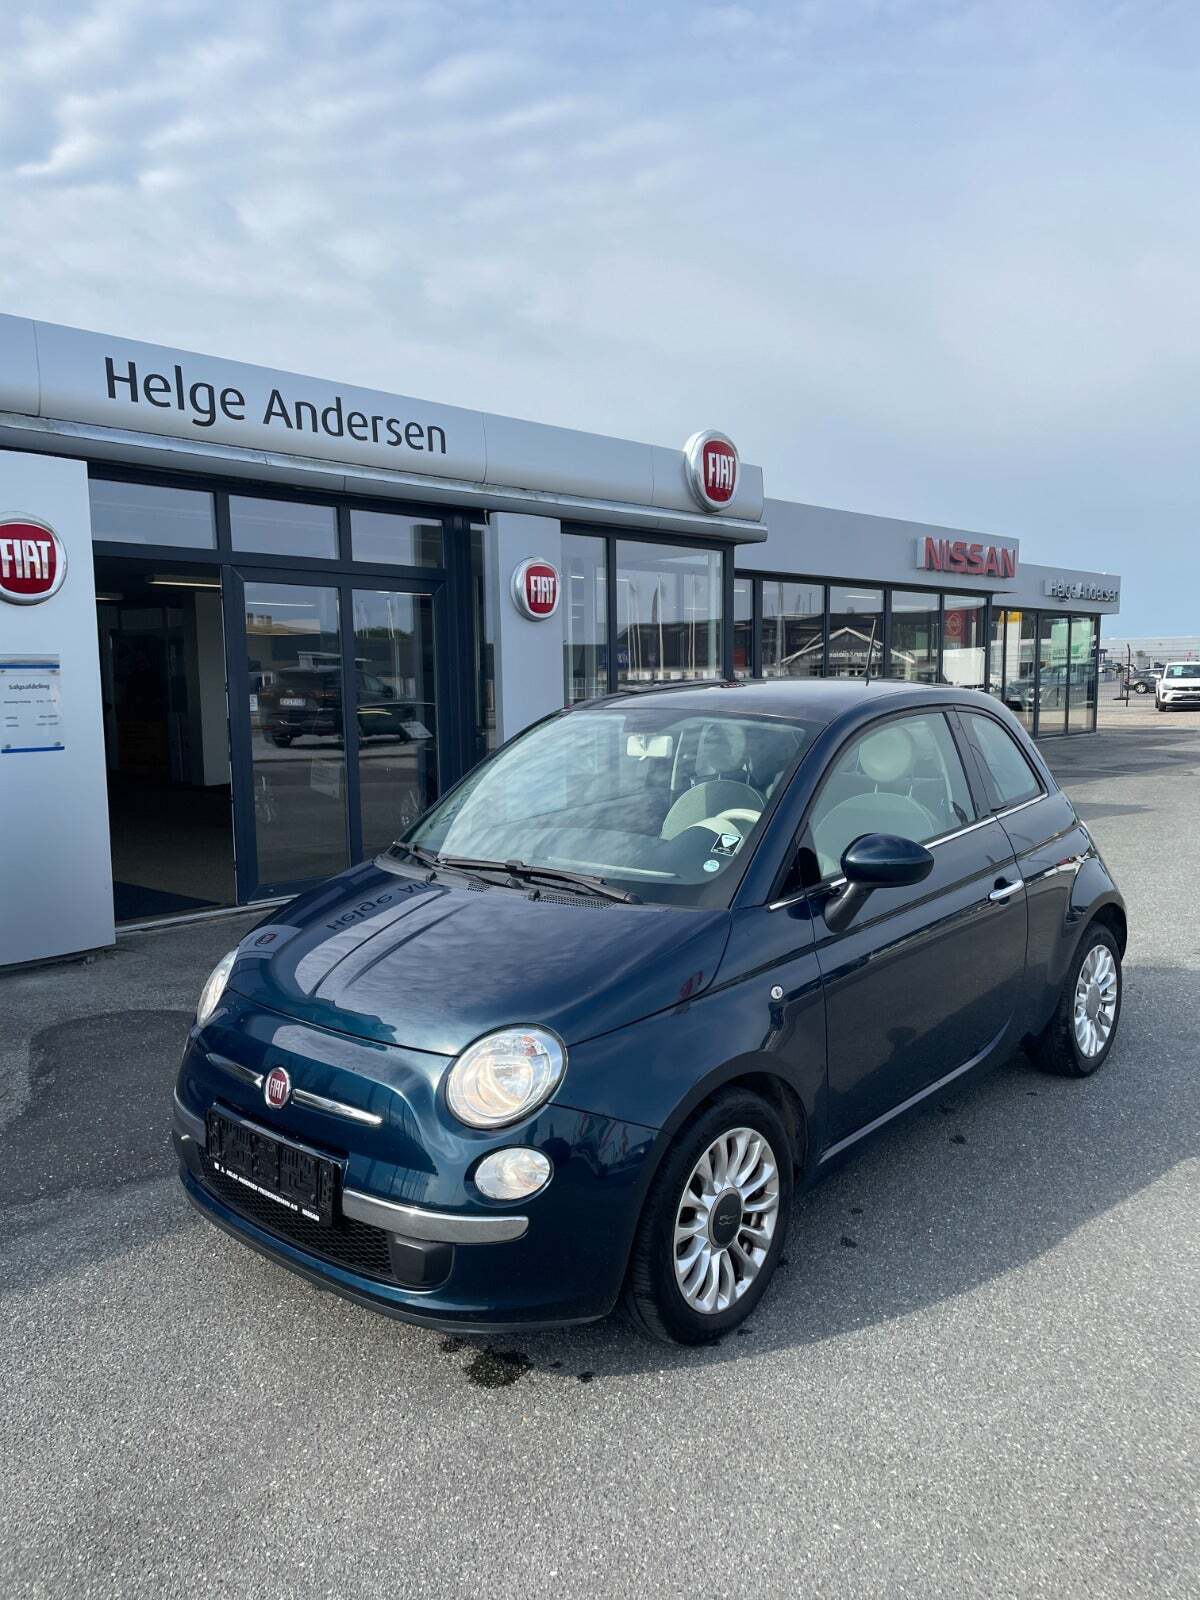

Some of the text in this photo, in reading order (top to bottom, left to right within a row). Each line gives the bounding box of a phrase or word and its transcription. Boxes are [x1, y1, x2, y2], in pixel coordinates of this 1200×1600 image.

[105, 356, 447, 454] Helge Andersen
[707, 452, 735, 490] FIAT
[0, 538, 51, 579] FIAT
[924, 536, 1016, 578] NISSAN
[530, 575, 555, 603] FIAT
[269, 1078, 286, 1100] FIAT
